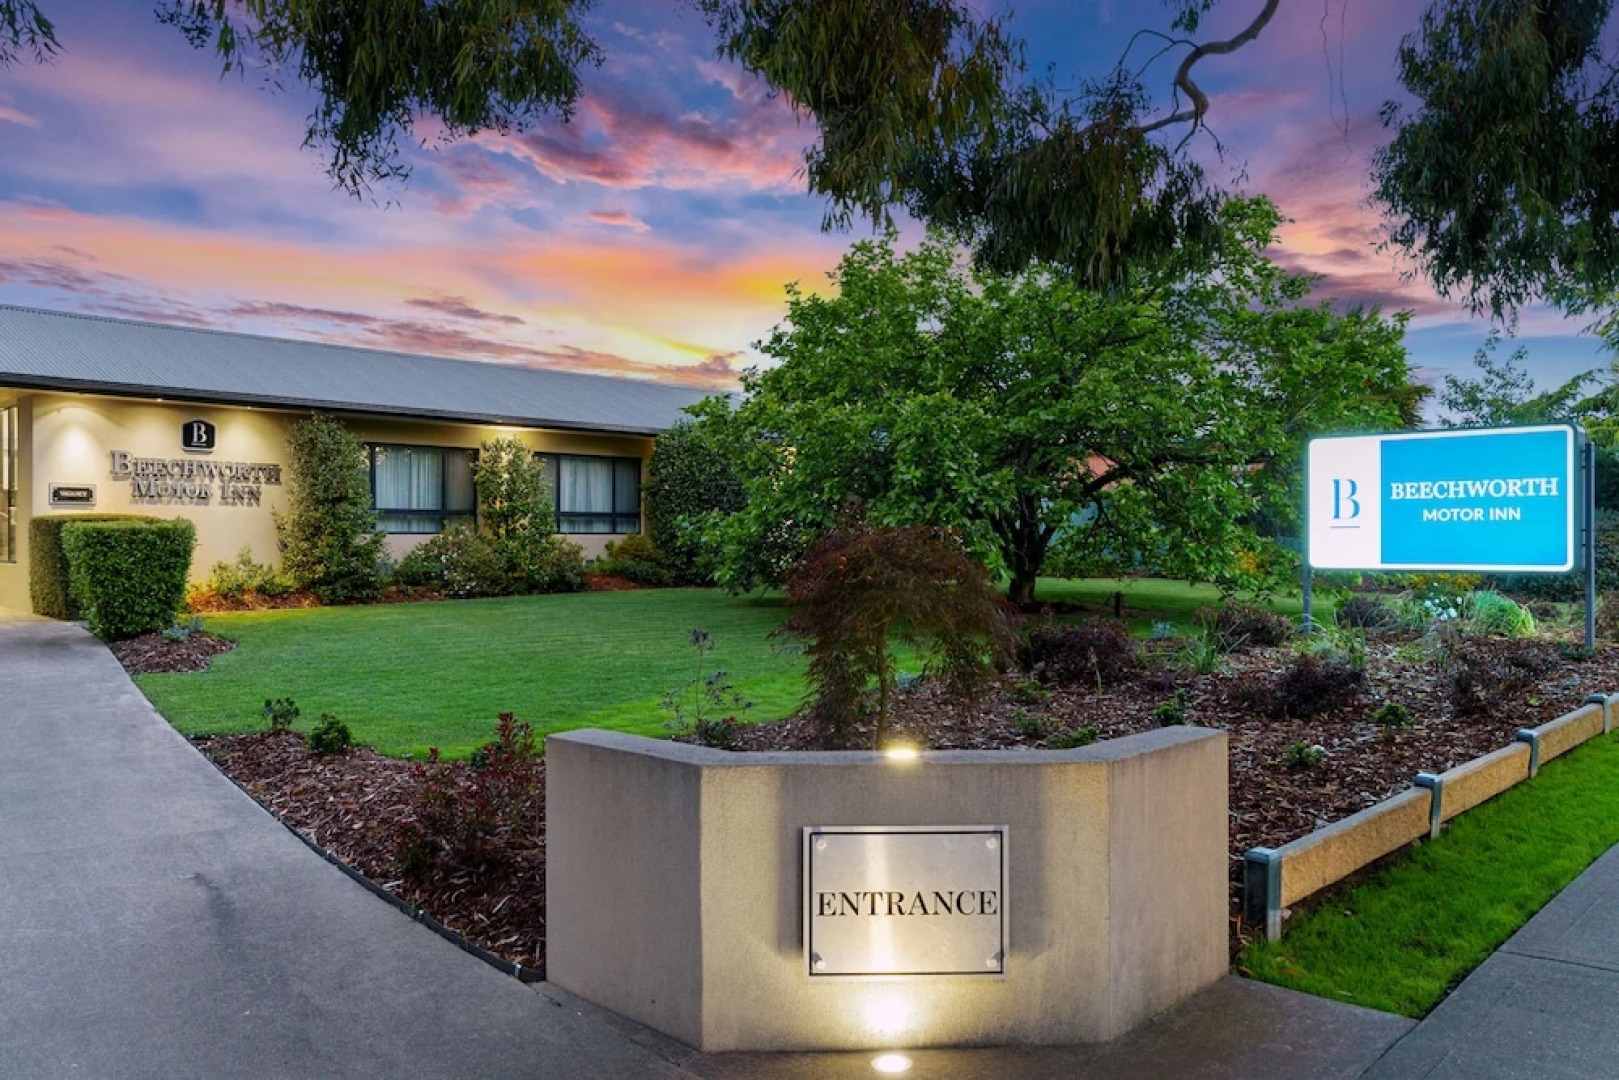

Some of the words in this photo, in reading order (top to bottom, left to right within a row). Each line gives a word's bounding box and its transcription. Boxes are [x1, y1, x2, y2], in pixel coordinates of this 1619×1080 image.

[192, 423, 208, 443] B
[111, 450, 281, 482] BEECHWORTH
[133, 476, 212, 499] MOTOR
[220, 479, 261, 505] INN
[1331, 479, 1360, 519] B
[1391, 478, 1558, 500] BEECHWORTH
[1422, 508, 1484, 521] MOTOR
[1489, 507, 1521, 520] INN
[816, 890, 997, 917] ENTRANCE
